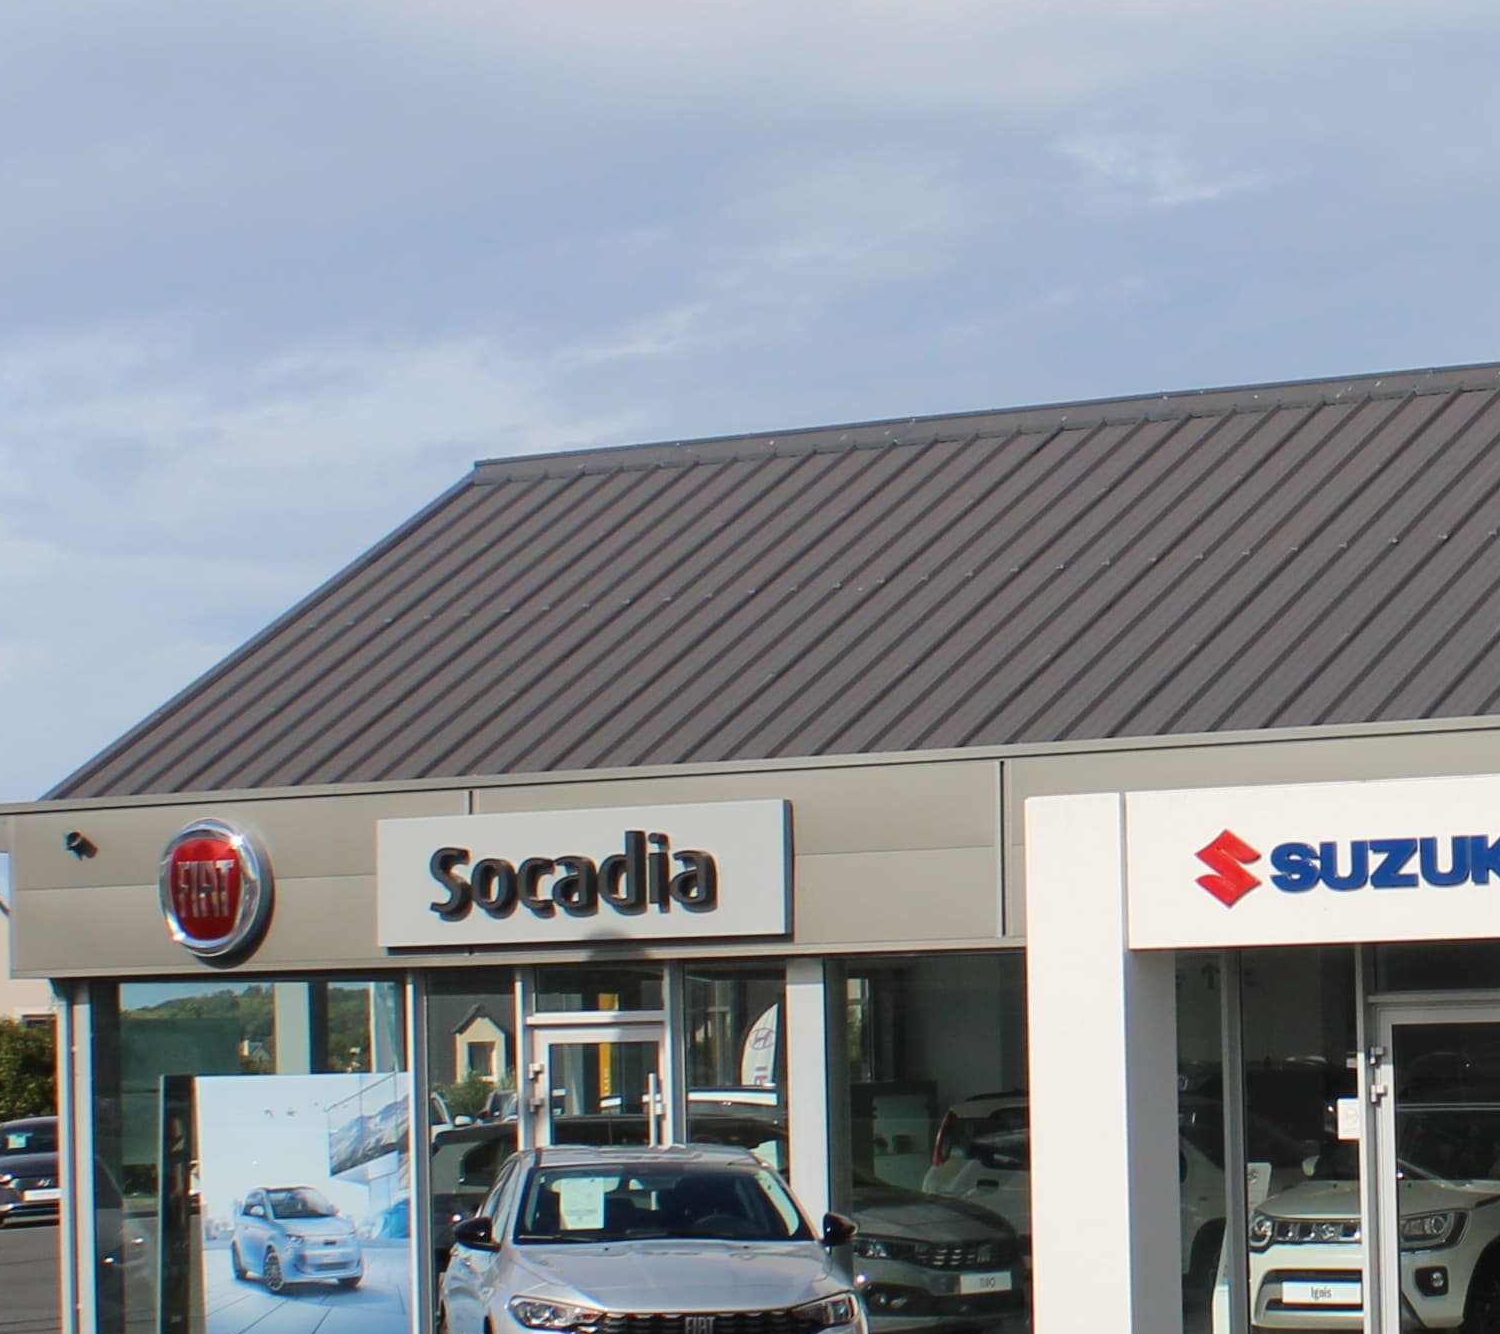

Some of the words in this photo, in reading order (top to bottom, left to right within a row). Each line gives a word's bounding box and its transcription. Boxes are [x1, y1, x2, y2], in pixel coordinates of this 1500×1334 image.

[177, 858, 235, 917] FIAT
[430, 830, 718, 921] Socadia
[1311, 1286, 1332, 1301] Ignis
